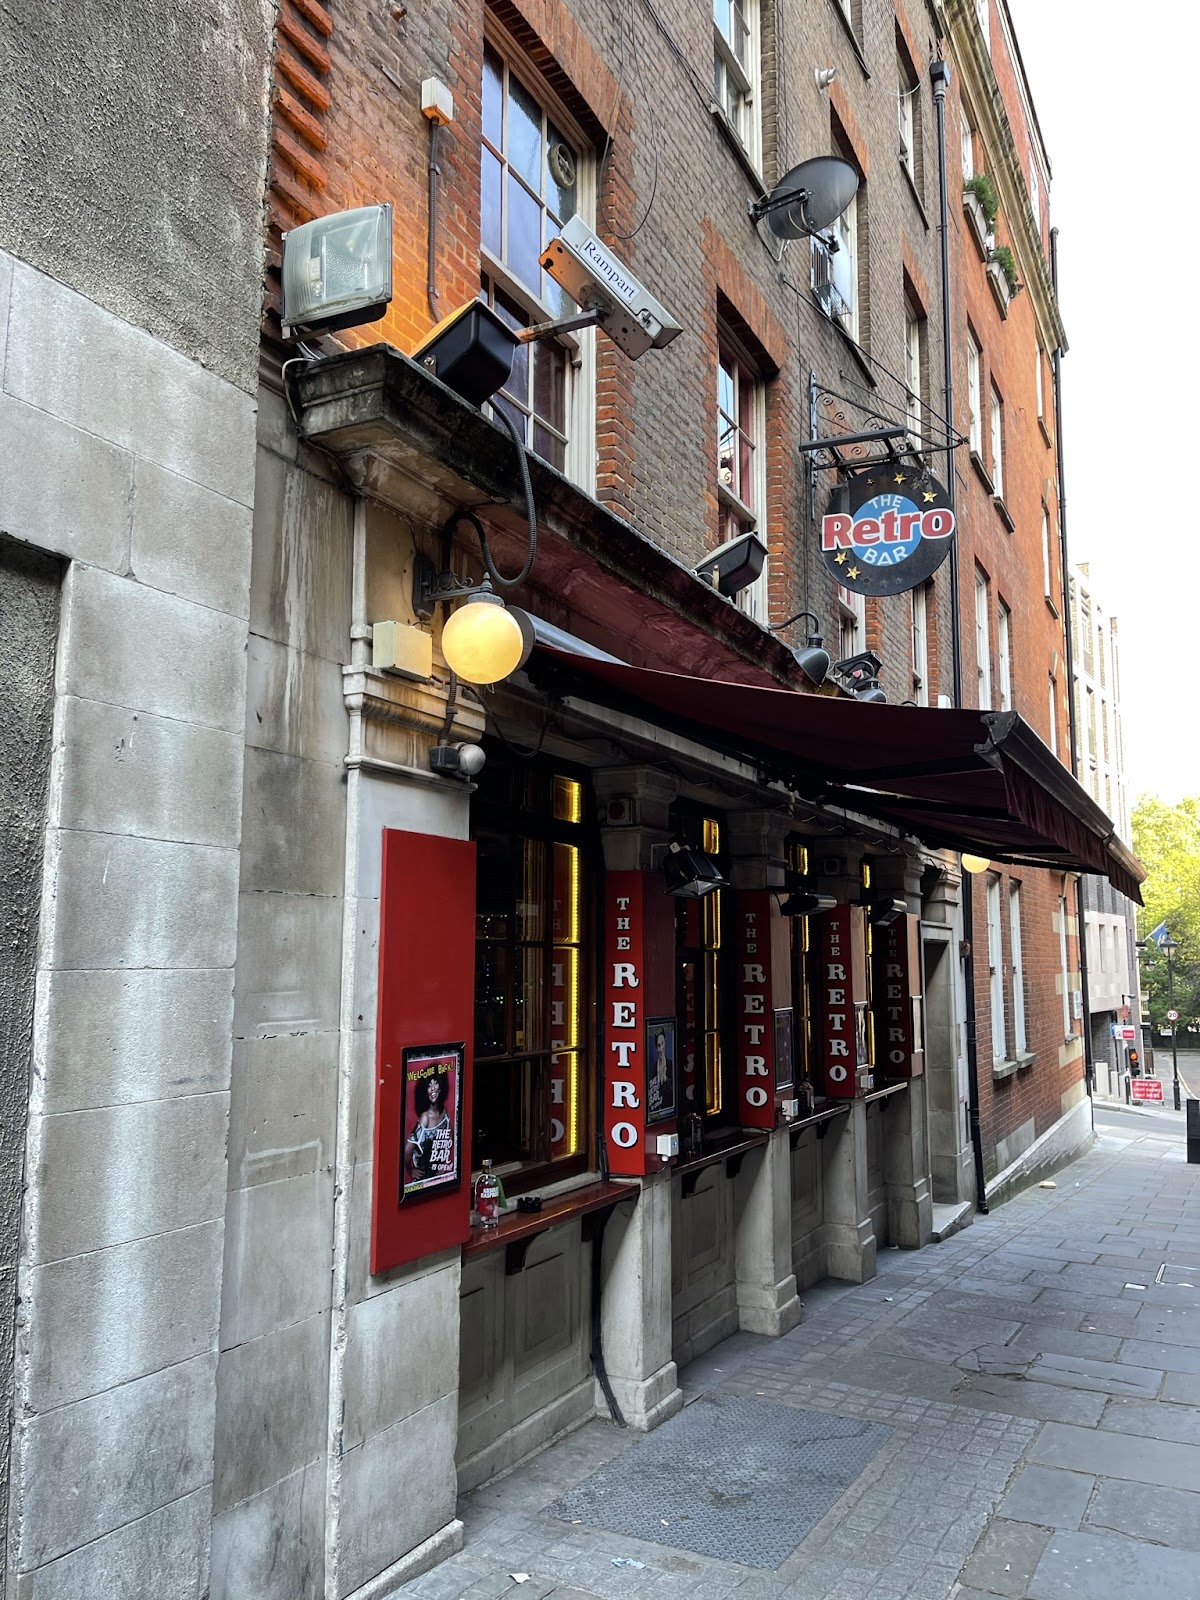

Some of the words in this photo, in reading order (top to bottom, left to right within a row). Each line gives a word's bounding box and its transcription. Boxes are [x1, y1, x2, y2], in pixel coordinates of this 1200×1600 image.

[584, 241, 636, 299] Rampart
[868, 494, 904, 509] THE
[822, 508, 956, 551] Retro
[862, 545, 909, 566] BAR
[616, 897, 631, 950] THE
[745, 913, 757, 954] THE
[830, 921, 840, 956] THE
[888, 928, 897, 957] THE
[827, 963, 849, 1082] RETRO
[886, 963, 906, 1064] RETRO
[743, 963, 769, 1107] RETRO
[611, 962, 640, 1148] RETRO
[407, 1066, 436, 1082] WELCOME
[431, 1139, 453, 1151] RETRO
[435, 1129, 452, 1140] THE
[429, 1150, 452, 1164] BAR
[431, 1163, 437, 1171] IS
